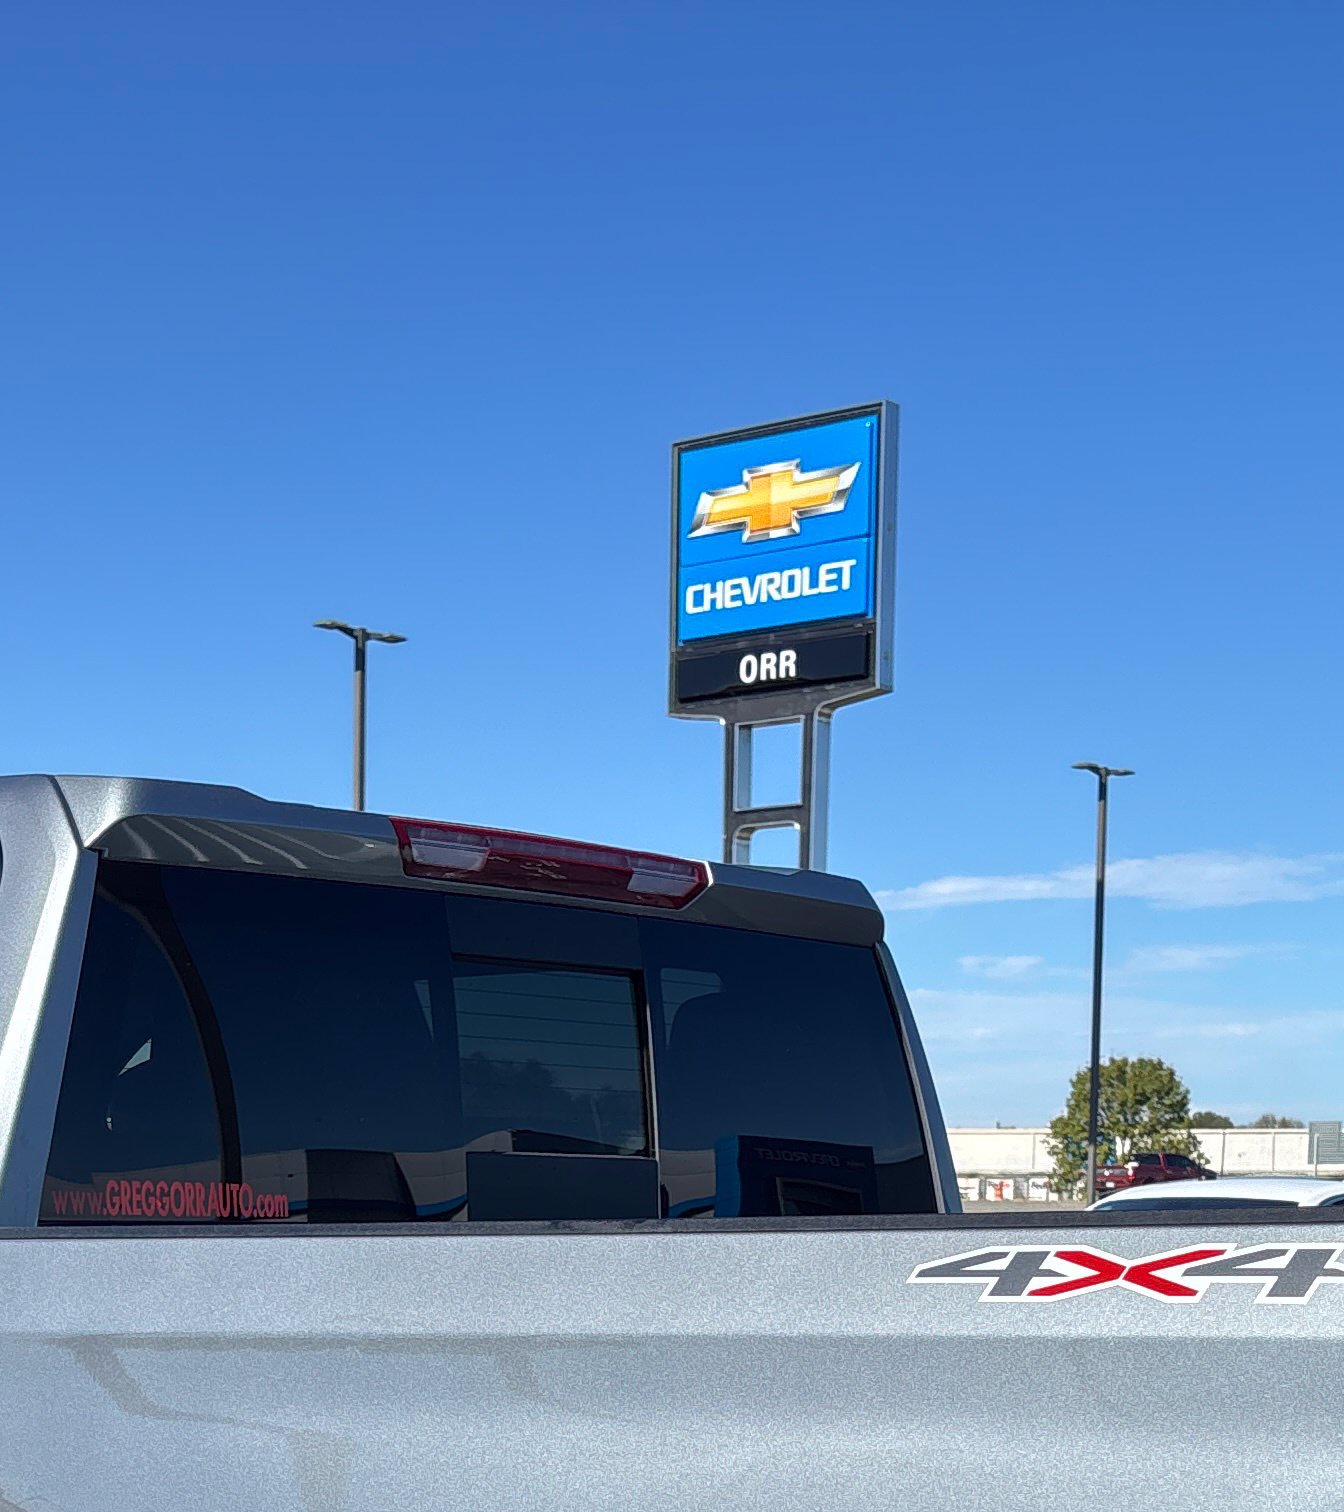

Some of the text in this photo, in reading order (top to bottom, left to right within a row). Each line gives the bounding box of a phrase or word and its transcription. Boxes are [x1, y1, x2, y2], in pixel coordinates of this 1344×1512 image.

[685, 559, 856, 614] CHEVROLET
[739, 650, 797, 683] ORR
[52, 1180, 288, 1217] www.GREGGORRAUTO.com
